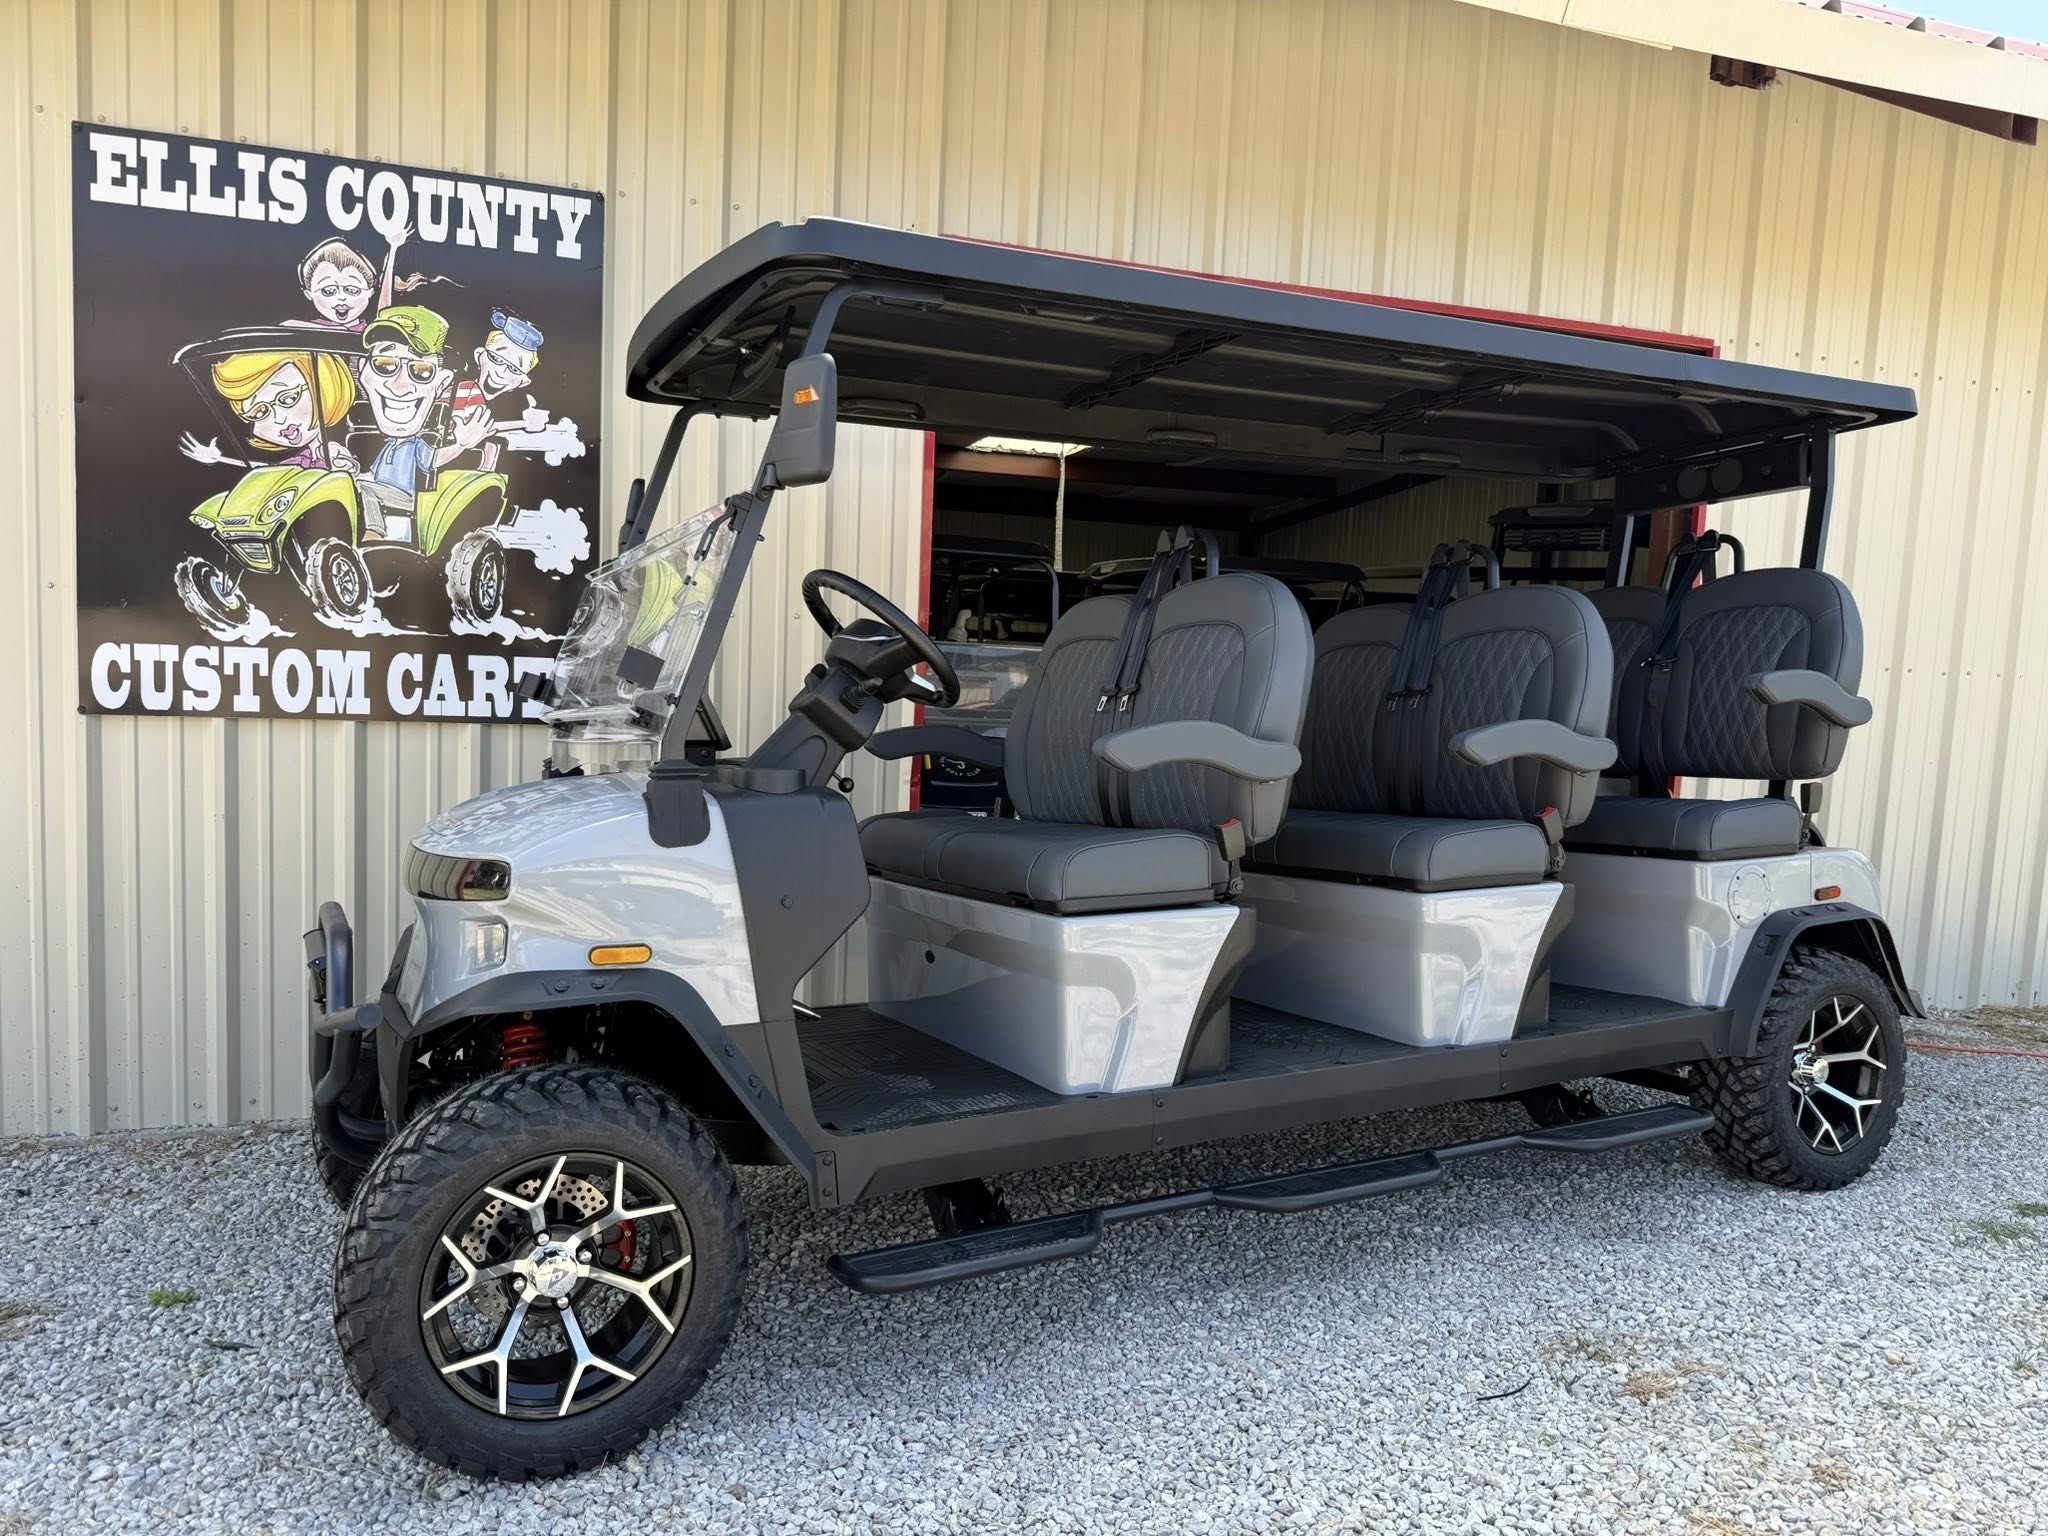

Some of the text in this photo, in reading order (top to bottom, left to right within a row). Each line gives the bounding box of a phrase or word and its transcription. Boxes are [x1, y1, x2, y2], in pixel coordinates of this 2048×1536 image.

[90, 132, 592, 260] ELLIS COUNTY
[91, 642, 574, 720] CUSTOM CART
